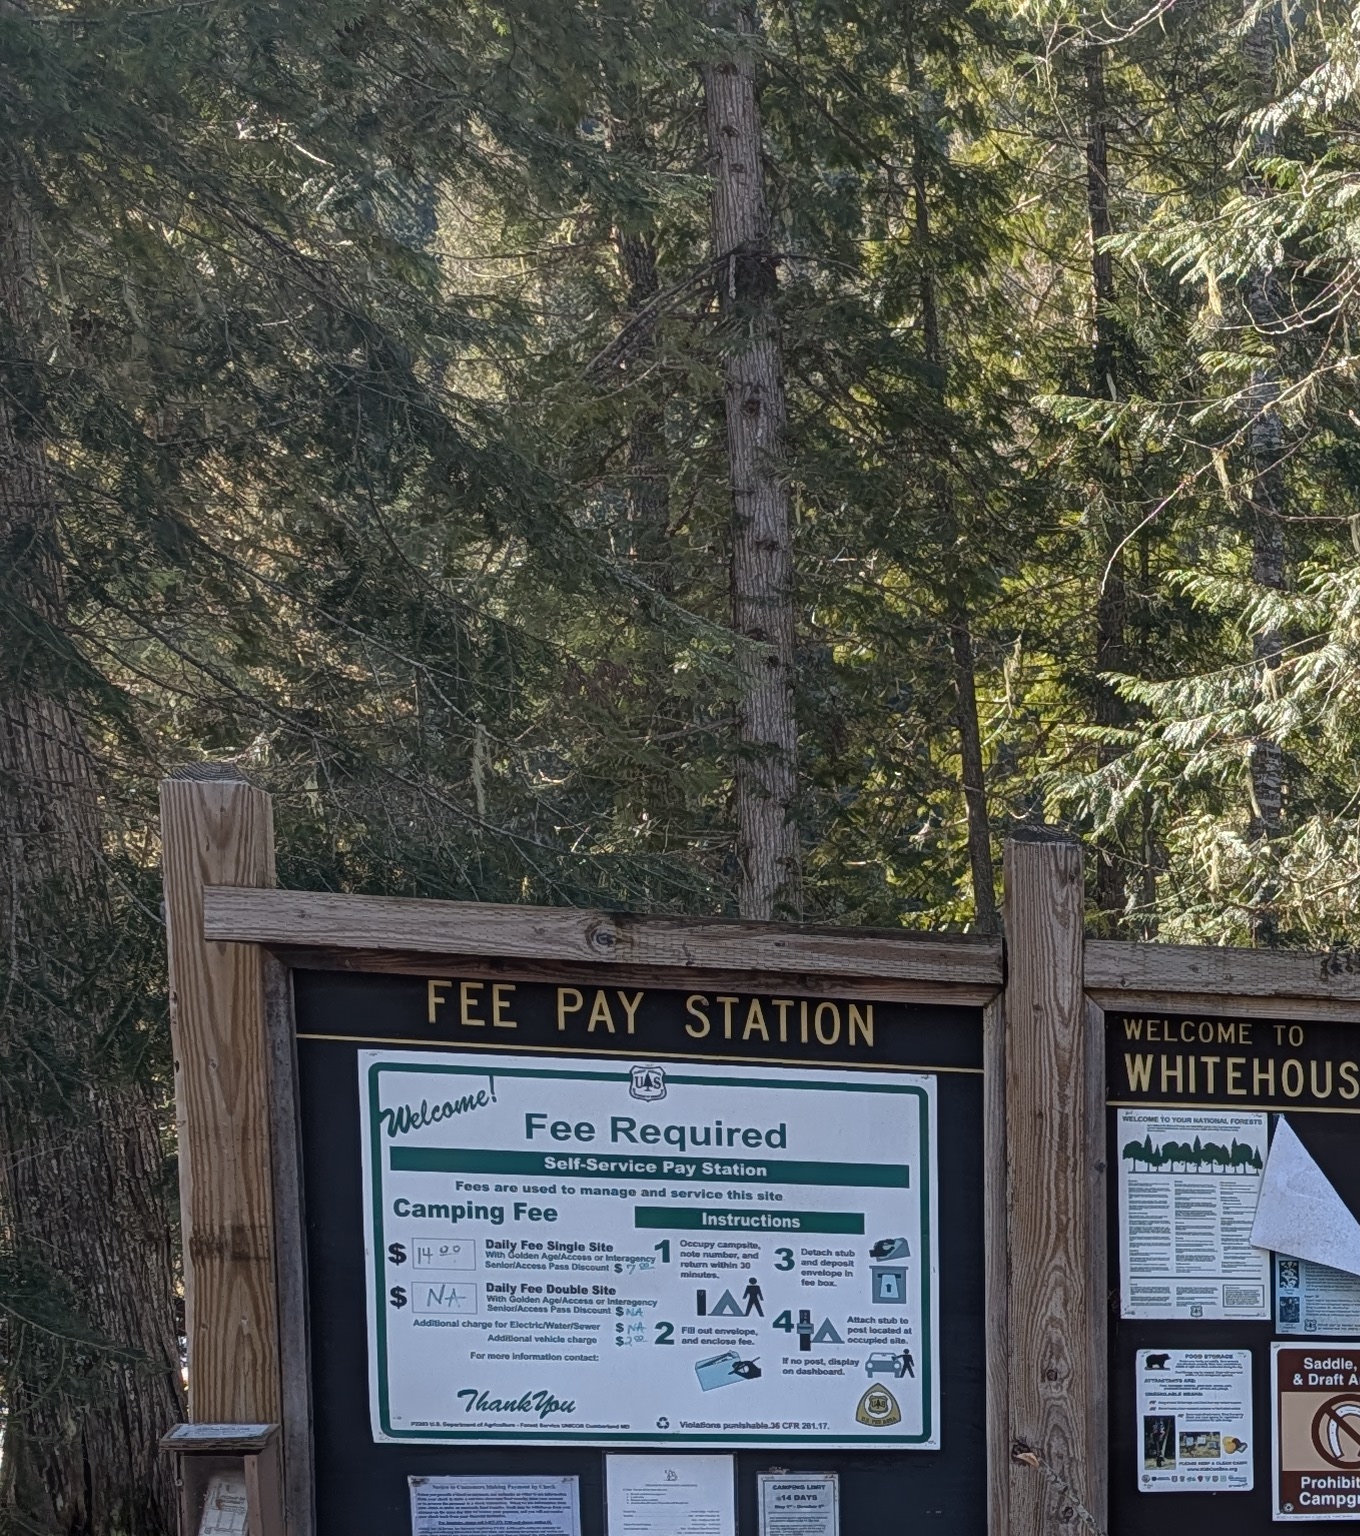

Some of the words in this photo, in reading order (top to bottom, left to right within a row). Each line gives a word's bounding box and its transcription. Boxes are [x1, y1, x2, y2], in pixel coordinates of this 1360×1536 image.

[428, 980, 518, 1028] FEE
[557, 987, 644, 1034] PAY
[685, 995, 874, 1047] STATION
[1123, 1018, 1253, 1045] WELCOME
[1273, 1025, 1304, 1047] TO
[380, 1074, 497, 1137] Welcome!
[525, 1113, 595, 1142] Fee
[610, 1116, 787, 1151] Required
[544, 1156, 657, 1173] Self-Service
[662, 1161, 696, 1177] Pay
[702, 1162, 767, 1177] Station
[455, 1181, 490, 1192] Fees
[494, 1184, 518, 1193] are
[522, 1184, 557, 1195] used
[561, 1185, 576, 1195] to
[580, 1188, 636, 1198] manage
[641, 1188, 666, 1198] and
[670, 1189, 723, 1199] service
[727, 1190, 753, 1200] this
[757, 1191, 783, 1201] site
[393, 1198, 504, 1225] Camping
[513, 1202, 558, 1222] Fee
[702, 1212, 800, 1228] Instructions
[485, 1239, 517, 1251] Daily
[521, 1240, 543, 1250] Fee
[547, 1241, 585, 1253] Single
[589, 1242, 614, 1252] Site
[655, 1239, 670, 1263] 1
[680, 1240, 715, 1249] Occupy
[717, 1241, 761, 1250] campsite,
[388, 1242, 407, 1266] $
[703, 1251, 740, 1259] number,
[801, 1248, 833, 1257] Detach
[835, 1249, 855, 1257] stub
[710, 1261, 738, 1269] within
[774, 1247, 795, 1271] 3
[820, 1260, 854, 1268] deposit
[680, 1271, 720, 1279] minutes.
[486, 1283, 517, 1295] Daily
[521, 1284, 542, 1293] Fee
[546, 1284, 589, 1295] Double
[592, 1286, 616, 1295] Site
[818, 1279, 837, 1287] box.
[390, 1286, 407, 1309] $
[413, 1319, 459, 1328] Additional
[461, 1320, 492, 1329] charge
[510, 1320, 600, 1331] Electric/Water/Sewer
[772, 1310, 794, 1333] 4
[847, 1316, 876, 1324] Attach
[655, 1321, 674, 1345] 2
[714, 1328, 758, 1336] envelope,
[847, 1327, 867, 1335] post
[487, 1334, 532, 1342] Additional
[534, 1336, 565, 1344] vehicle
[568, 1336, 597, 1345] charge
[847, 1337, 888, 1345] occupied
[890, 1337, 908, 1345] site.
[470, 1352, 486, 1360] For
[512, 1353, 562, 1361] information
[564, 1354, 599, 1362] contact:
[782, 1357, 789, 1365] If
[804, 1358, 826, 1366] post,
[828, 1358, 859, 1367] display
[1304, 1358, 1357, 1371] Saddle,
[796, 1368, 845, 1376] dashboard.
[1292, 1374, 1303, 1385] &
[1308, 1374, 1344, 1385] Draft
